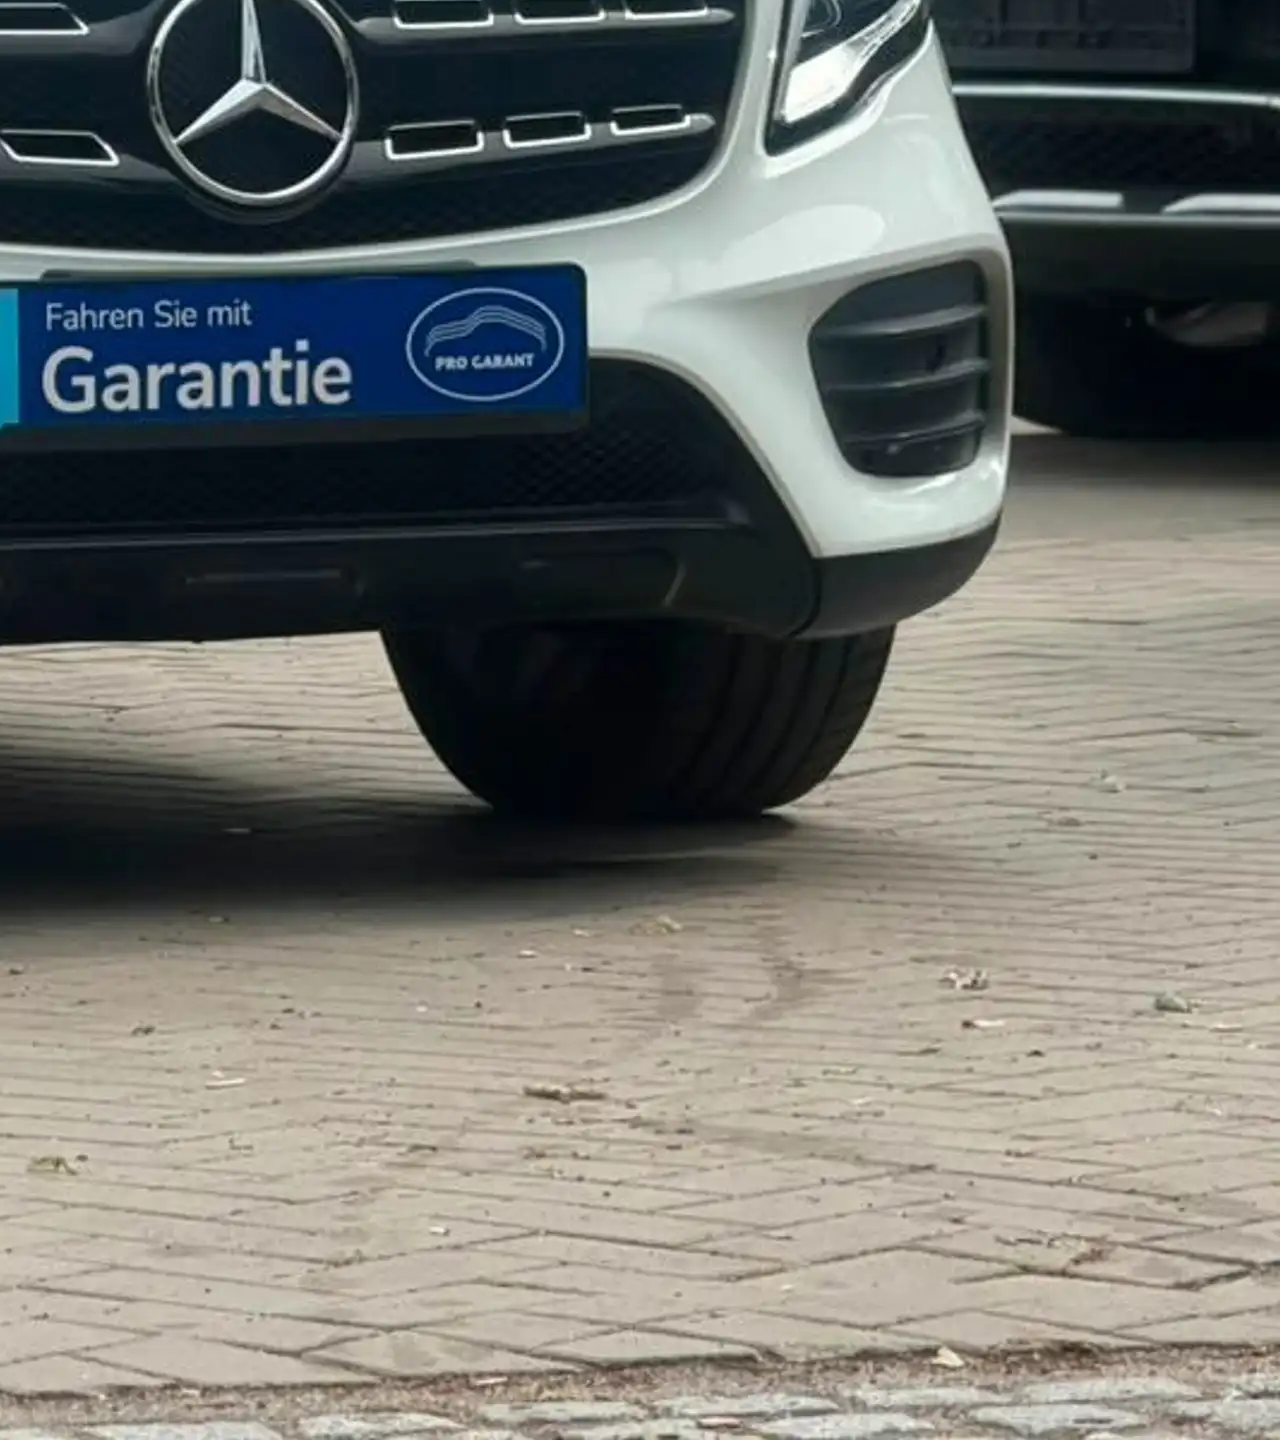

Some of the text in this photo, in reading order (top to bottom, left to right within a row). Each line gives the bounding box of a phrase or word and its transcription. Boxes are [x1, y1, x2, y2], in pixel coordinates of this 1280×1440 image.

[46, 298, 252, 331] Fahren Sie mit
[42, 339, 352, 413] Garantie
[435, 353, 535, 370] PRO GARANT
